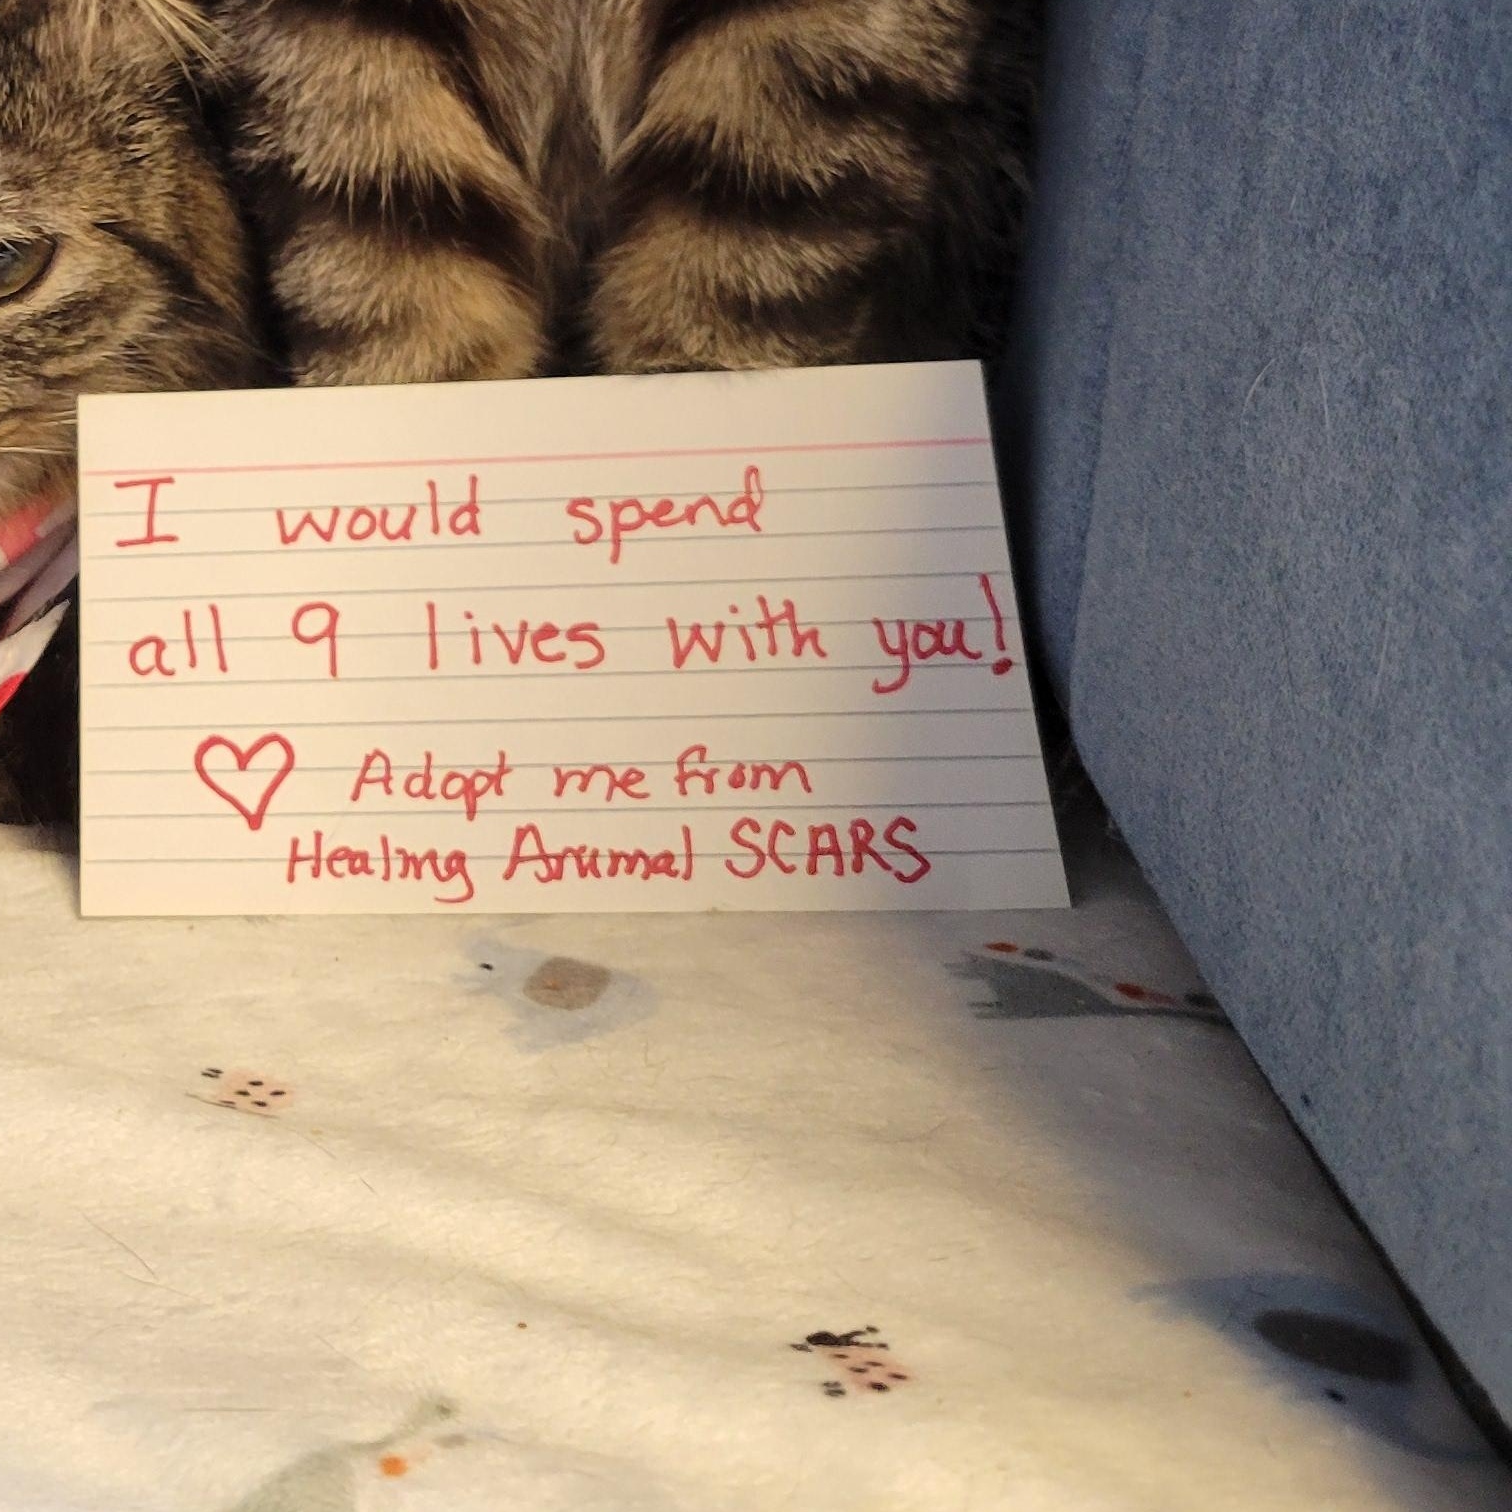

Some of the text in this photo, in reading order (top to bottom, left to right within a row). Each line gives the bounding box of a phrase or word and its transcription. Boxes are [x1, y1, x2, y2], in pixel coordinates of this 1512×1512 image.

[114, 466, 763, 564] I would spend
[128, 574, 1012, 695] all 9 lives with you!
[350, 745, 812, 821] Adopt me from
[287, 817, 931, 904] Healing Animal SCARS
